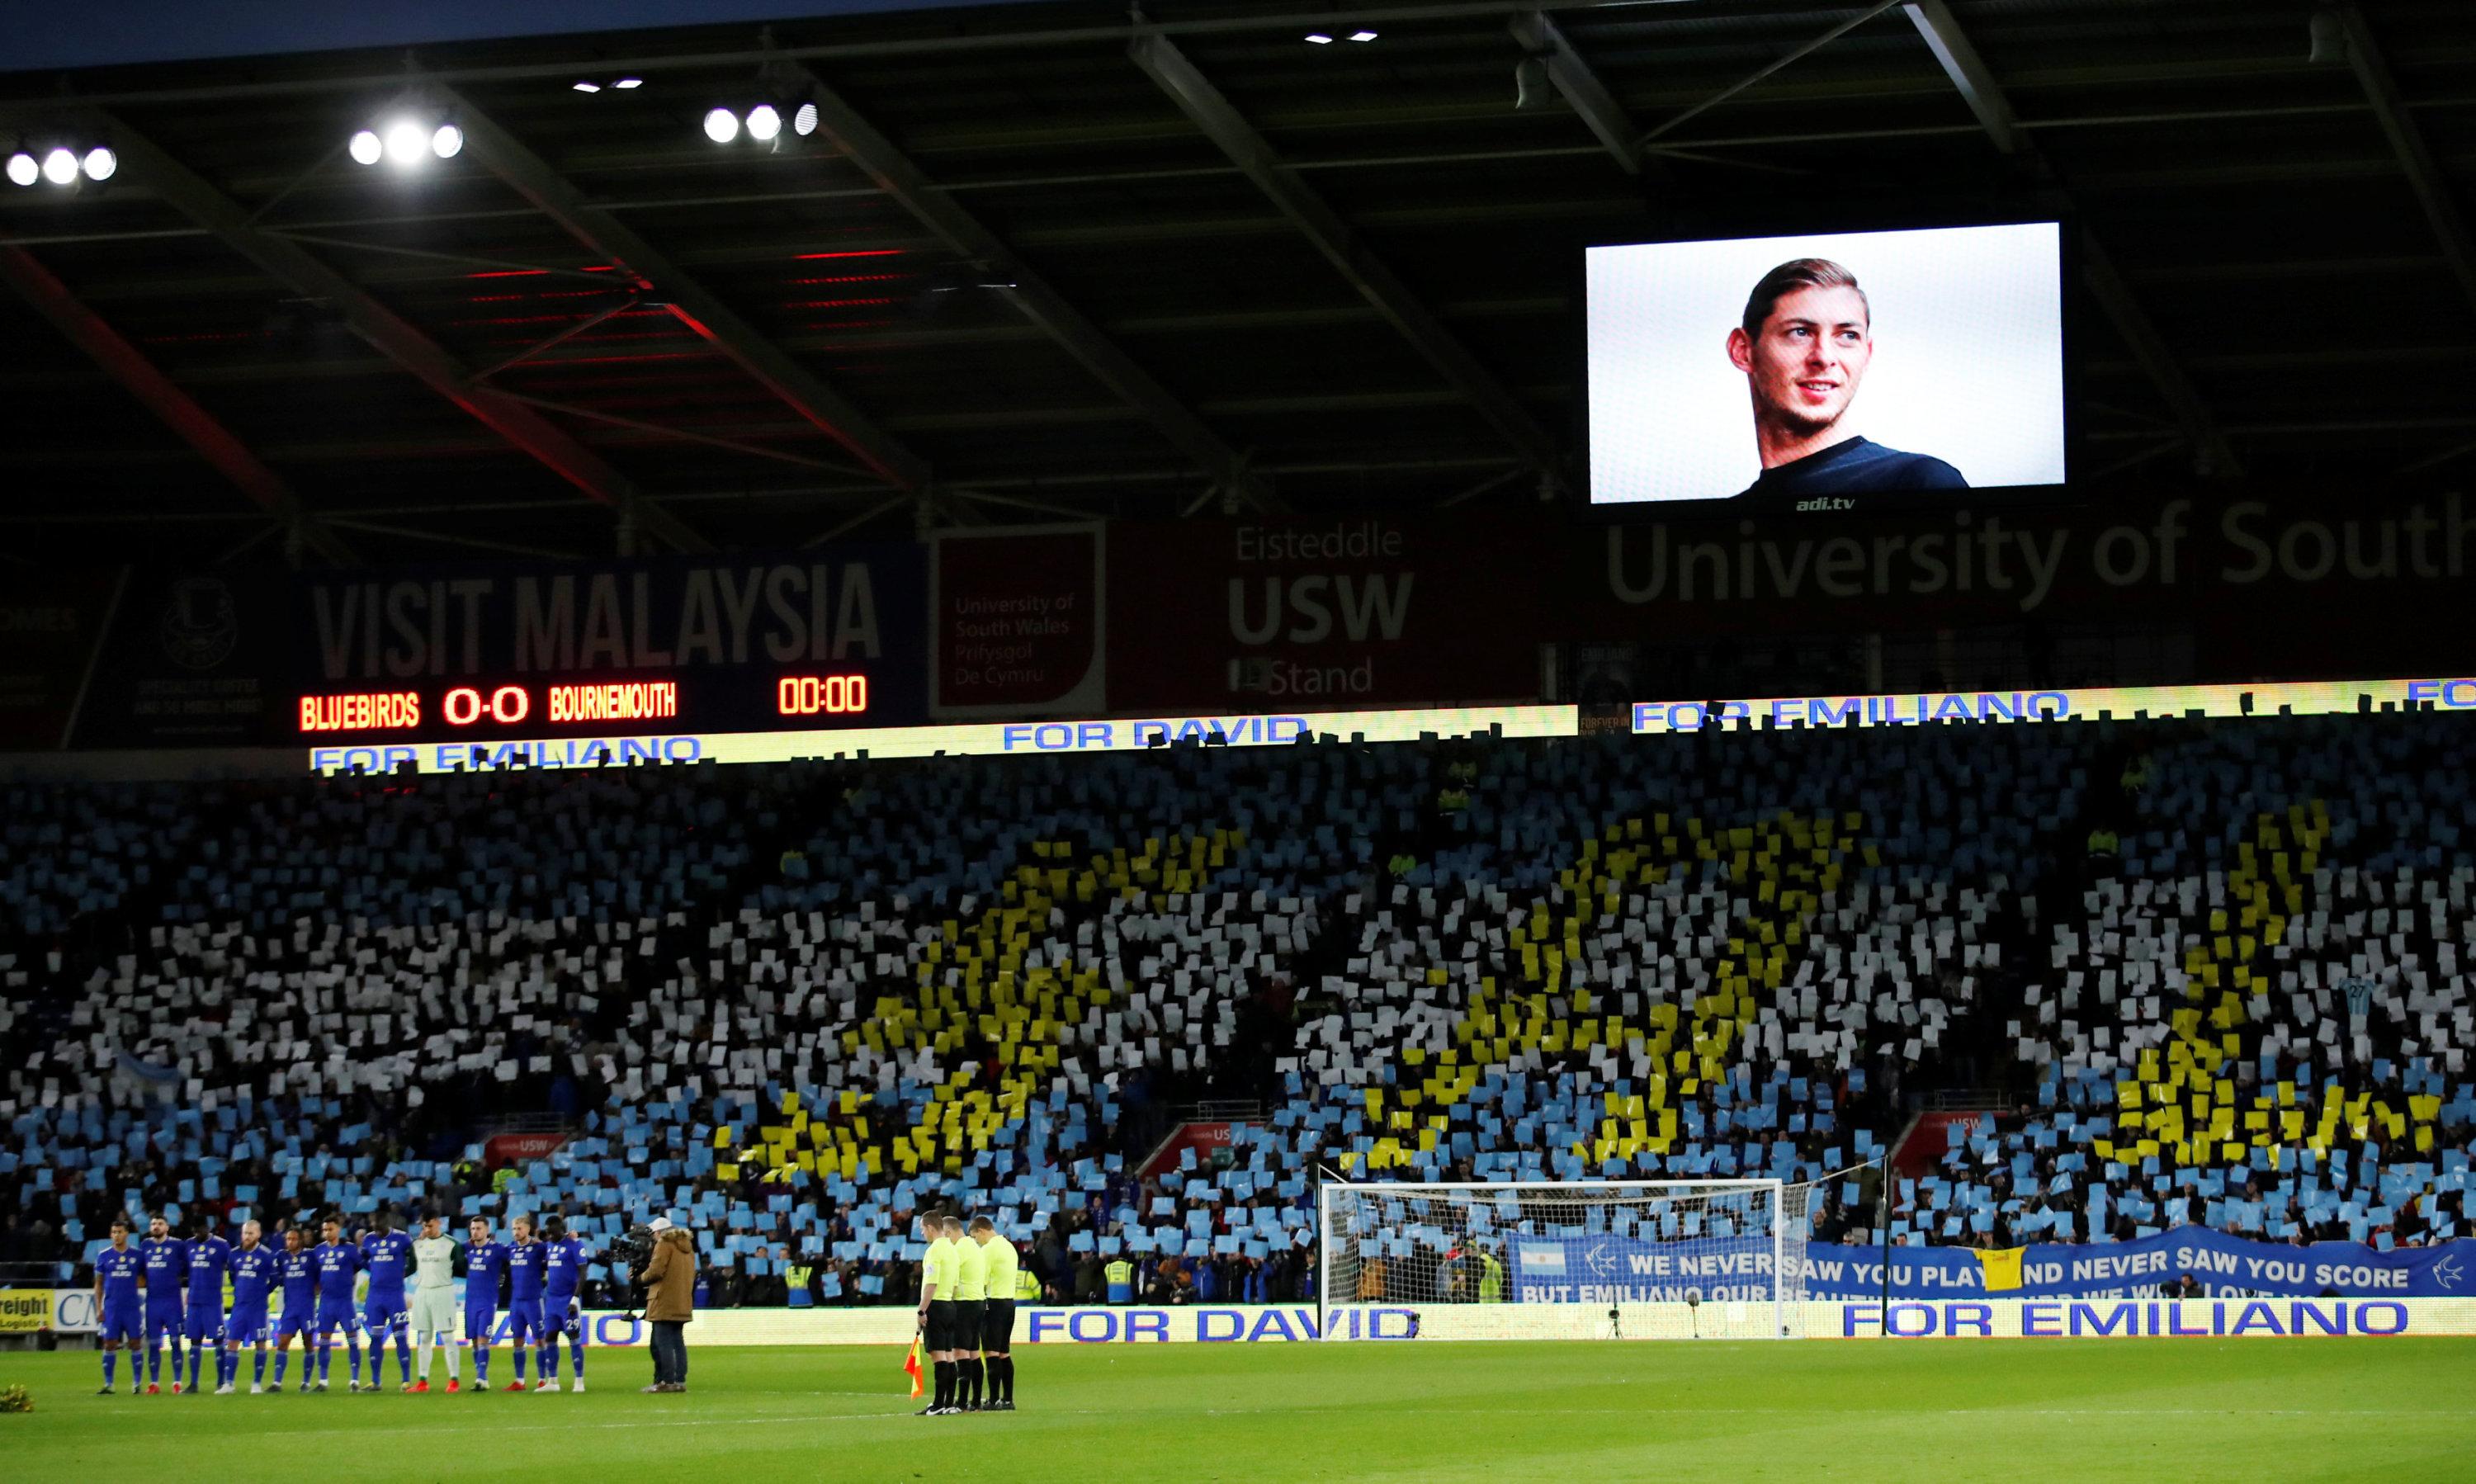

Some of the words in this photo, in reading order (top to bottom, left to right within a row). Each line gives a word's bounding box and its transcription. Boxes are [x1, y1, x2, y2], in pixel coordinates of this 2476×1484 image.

[1796, 497, 1855, 511] adi.tv
[1237, 520, 1402, 561] Eisteddle
[1607, 509, 2069, 614] University
[2093, 499, 2191, 586] of
[312, 578, 494, 679] VISIT
[514, 561, 883, 671] MALAYSIA
[955, 595, 1049, 615] University
[1055, 593, 1075, 611] of
[1227, 571, 1415, 645] USW
[956, 619, 1011, 638] South
[1016, 618, 1070, 635] Wales
[955, 644, 1032, 663] Prifysgol
[955, 669, 980, 686] De
[985, 667, 1044, 687] Cymru
[1266, 655, 1373, 696] Stand
[300, 692, 421, 730] BLUEBIRDS
[442, 686, 529, 726] 0-0
[548, 682, 677, 722] BOURNEMOUTH
[777, 675, 867, 716] 00:00
[1772, 692, 2069, 725] EMILIANO
[1004, 723, 1113, 750] FOR
[1134, 717, 1309, 747] DAVID
[437, 736, 701, 769] EMILIANO
[520, 1140, 548, 1152] USW
[1214, 1129, 1231, 1141] US
[1628, 1254, 1670, 1275] WE
[1679, 1252, 1774, 1275] NEVER
[1782, 1255, 1844, 1282] SAW
[1852, 1263, 1911, 1286] YOU
[2023, 1263, 2063, 1284] ND
[2072, 1250, 2168, 1281] NEVER
[2176, 1246, 2237, 1274] SAW
[2245, 1256, 2305, 1283] YOU
[2314, 1264, 2408, 1288] SCORE
[1522, 1284, 1571, 1302] BUT
[1580, 1284, 1703, 1302] EMILIANO
[1712, 1284, 1767, 1302] OUR
[1030, 1310, 1169, 1342] FOR
[1198, 1308, 1419, 1341] DAVID
[1842, 1303, 1993, 1338] FOR
[2021, 1301, 2408, 1336] EMILIANO
